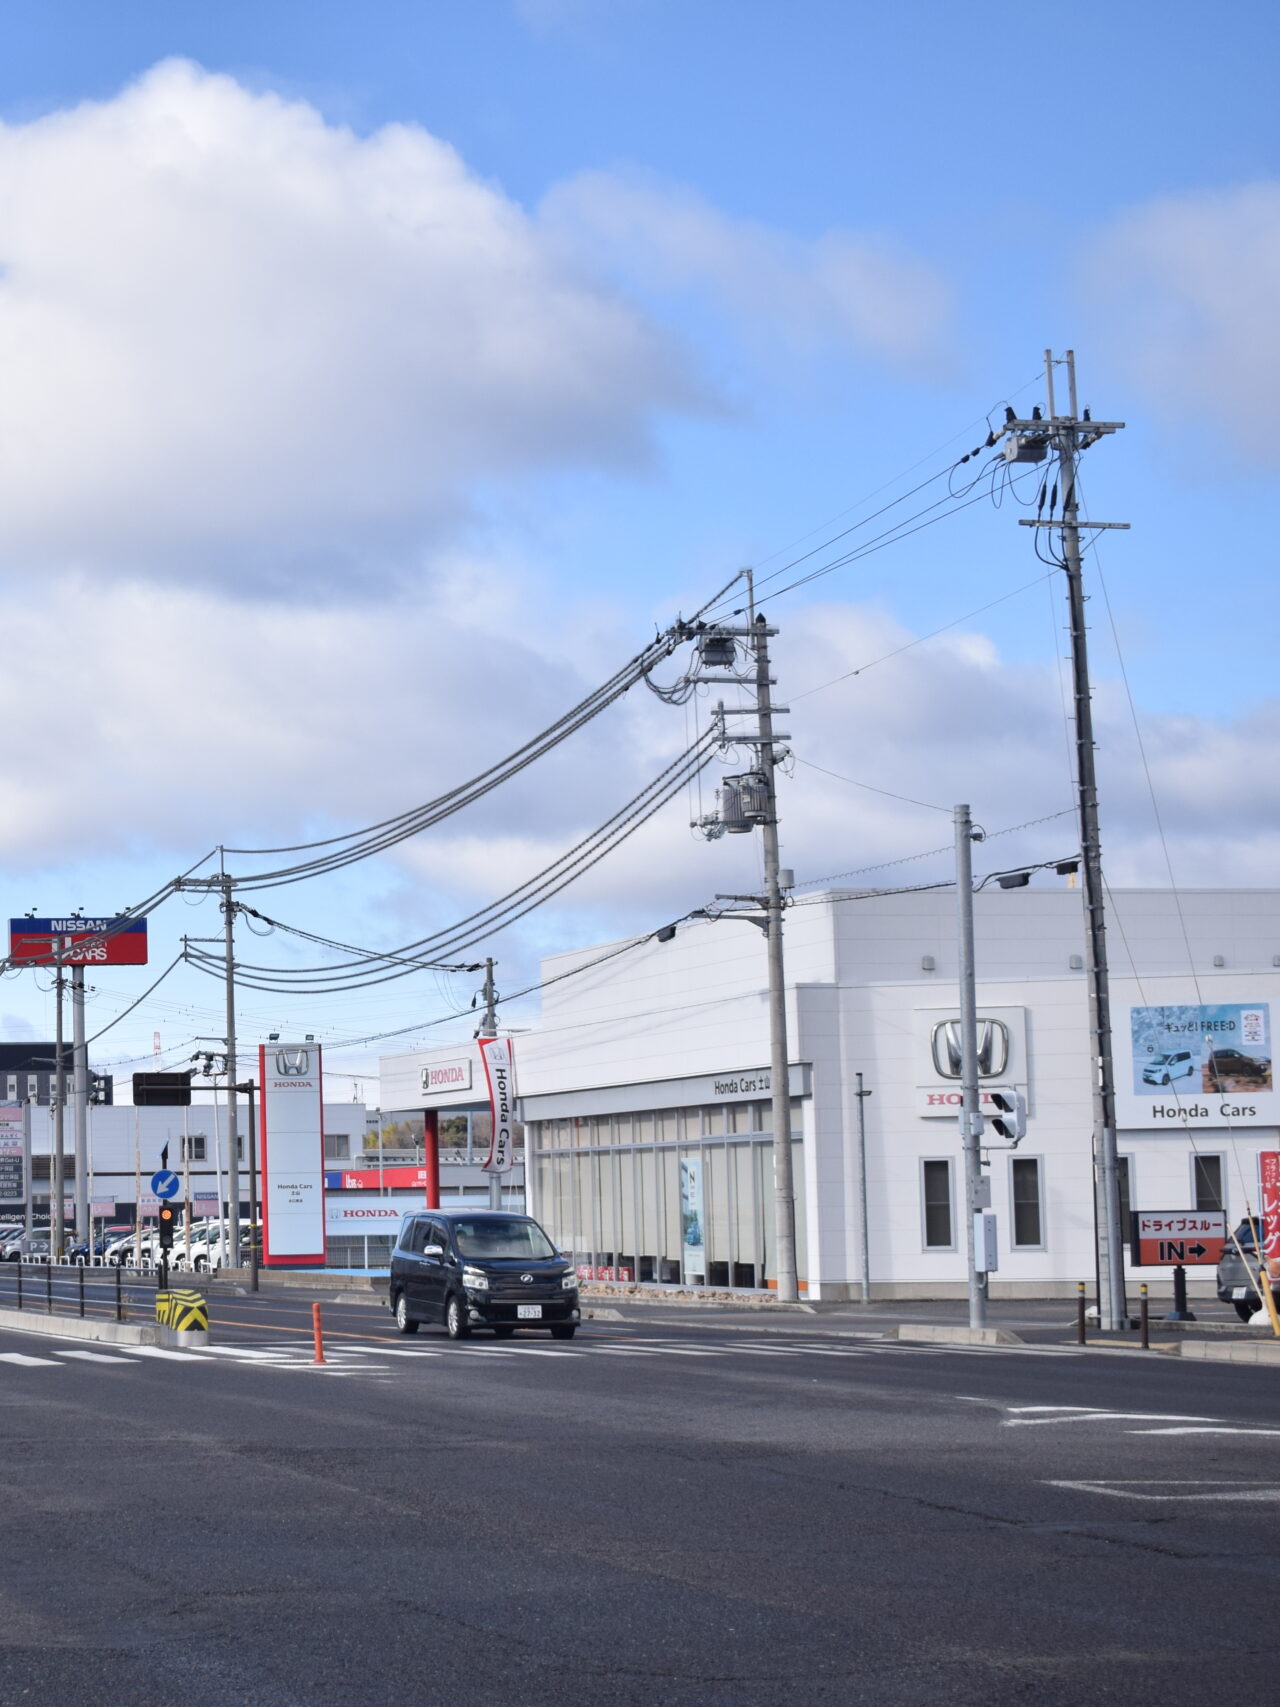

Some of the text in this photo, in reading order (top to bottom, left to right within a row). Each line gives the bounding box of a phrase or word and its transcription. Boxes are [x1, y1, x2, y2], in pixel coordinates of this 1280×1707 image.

[51, 920, 107, 931] NISSAN
[430, 1067, 465, 1086] HONDA
[714, 1079, 739, 1095] Honda
[740, 1077, 757, 1093] Cars
[496, 1068, 510, 1166] Honda Cars
[1152, 1103, 1256, 1118] Honda Cars
[343, 1209, 399, 1217] HONDA
[1141, 1219, 1222, 1232] ドライブスルー
[30, 1242, 37, 1250] P
[1159, 1241, 1185, 1261] IN
